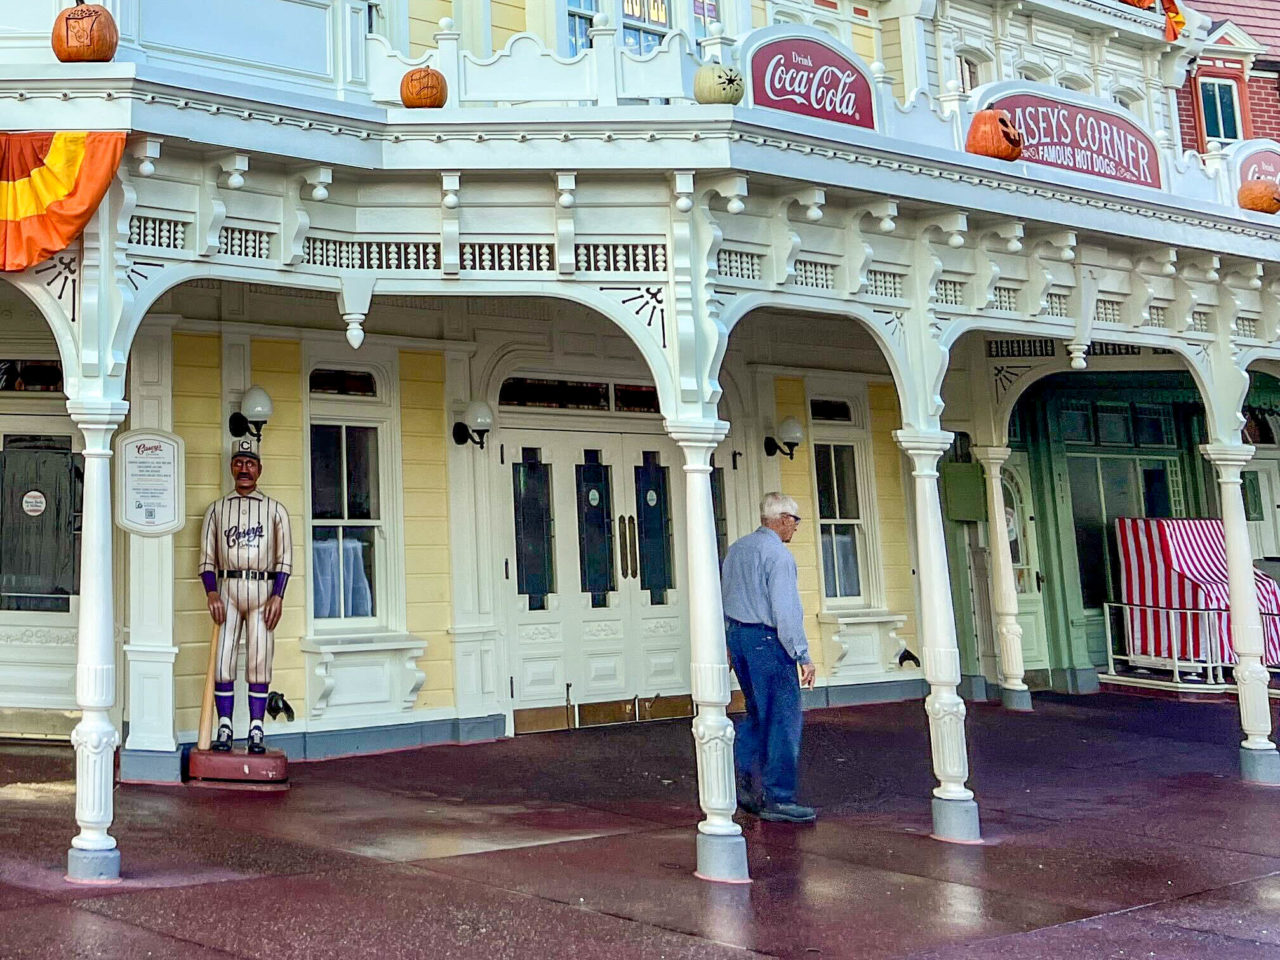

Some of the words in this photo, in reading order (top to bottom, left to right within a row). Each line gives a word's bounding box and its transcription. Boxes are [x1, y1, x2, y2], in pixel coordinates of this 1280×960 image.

[791, 51, 813, 67] Drink
[764, 54, 857, 116] Coca-Cola
[1003, 105, 1071, 146] ASEY'S
[1075, 113, 1152, 183] CORNER
[1038, 145, 1073, 167] FAMOUS
[1075, 149, 1091, 170] HOT
[1093, 154, 1116, 176] DOGS
[241, 441, 250, 450] C
